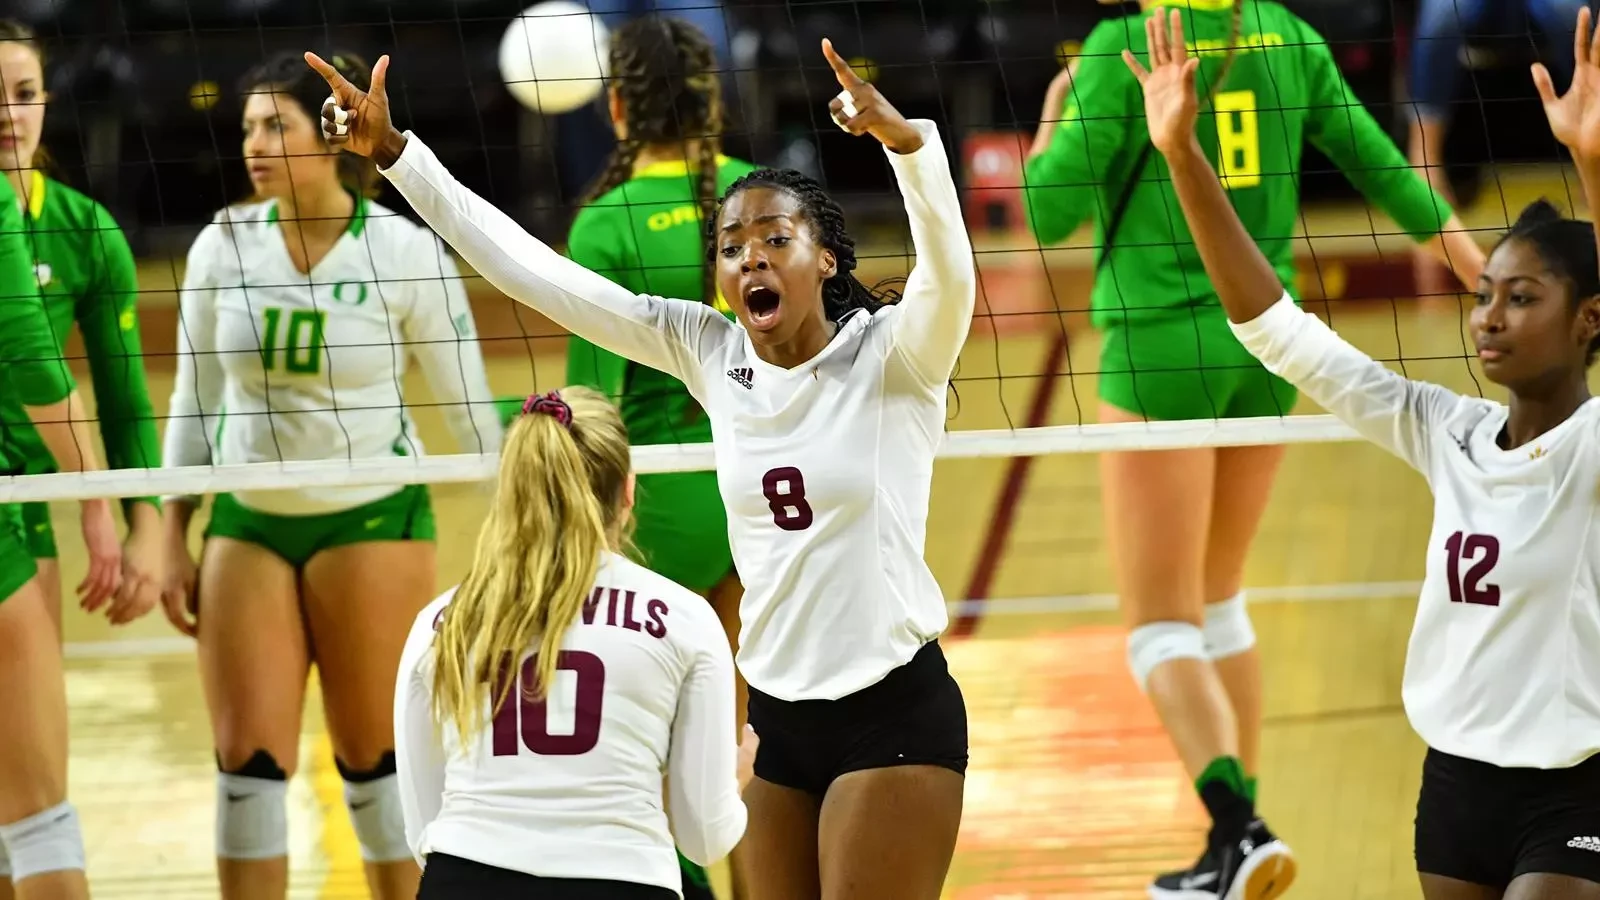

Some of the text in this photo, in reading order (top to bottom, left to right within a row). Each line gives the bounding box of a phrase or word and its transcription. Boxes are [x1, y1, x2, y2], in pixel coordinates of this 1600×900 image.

[1214, 89, 1261, 189] 8
[262, 307, 326, 374] 10
[727, 370, 754, 390] adidas
[762, 466, 813, 531] 8
[1444, 531, 1501, 606] 12
[580, 586, 669, 639] VILS
[476, 648, 606, 757] 10
[1567, 840, 1600, 853] adida
